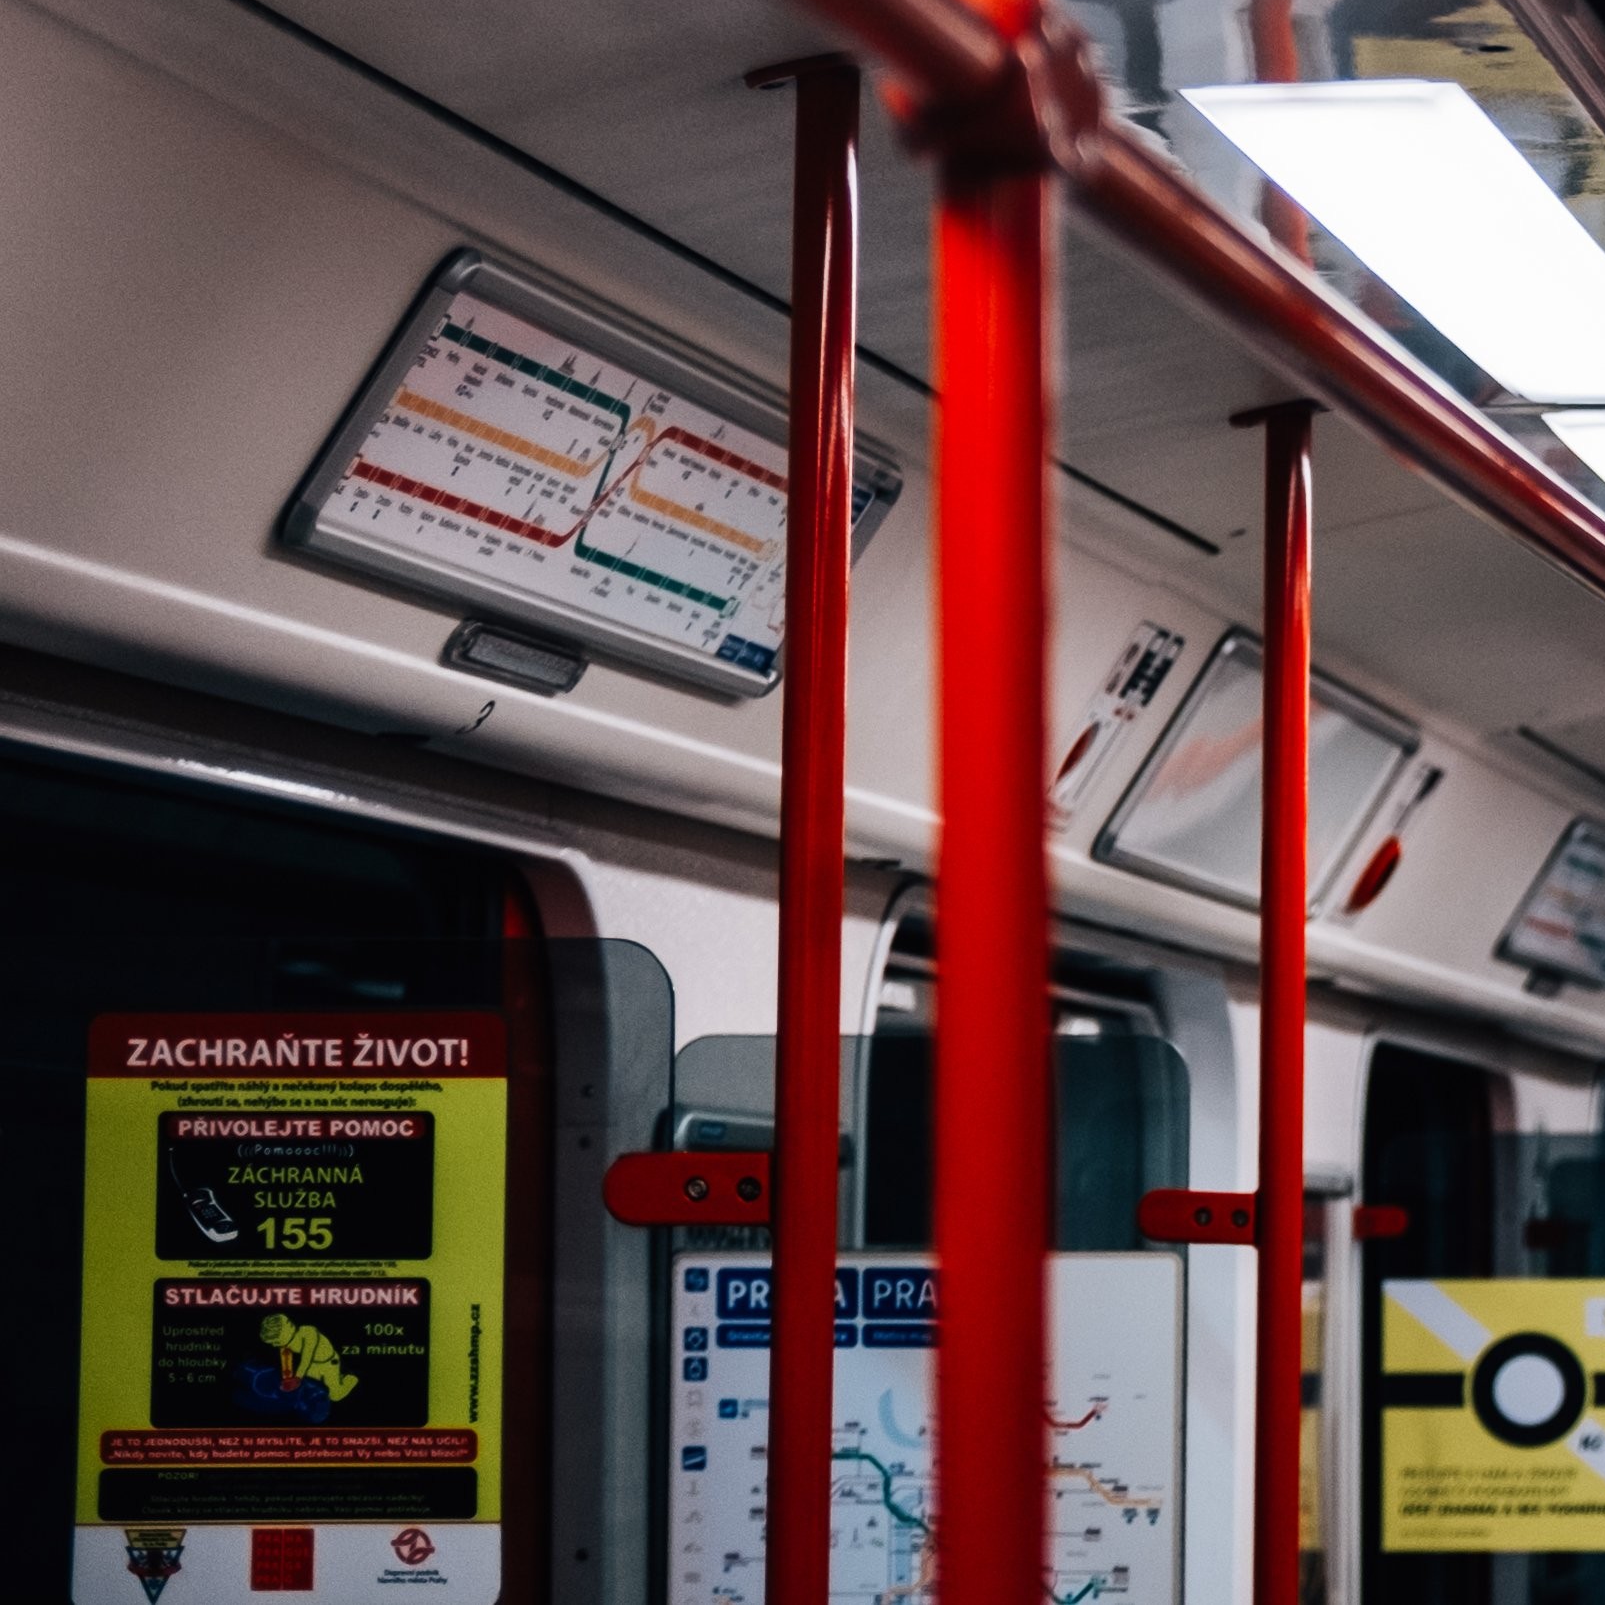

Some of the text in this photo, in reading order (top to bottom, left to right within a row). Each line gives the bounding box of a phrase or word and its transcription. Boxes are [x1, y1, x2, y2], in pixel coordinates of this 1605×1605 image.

[126, 1032, 469, 1067] ZACHRAŇTE ŽIVOT!
[151, 1081, 188, 1091] Pokud
[178, 1116, 415, 1137] PŘIVOLEJTE POMOC
[227, 1163, 364, 1185] ZÁCHRANNÁ
[253, 1188, 336, 1209] SLUŽBA
[257, 1217, 334, 1250] 155
[165, 1283, 419, 1305] STLAČUJTE HRUDNÍK
[727, 1278, 847, 1309] PRA
[162, 1325, 224, 1338] Uprostřed
[363, 1323, 405, 1336] 100x
[341, 1343, 425, 1356] za minutu
[158, 1357, 227, 1370] do hloubky
[186, 1372, 194, 1383] 6
[198, 1374, 216, 1383] cm
